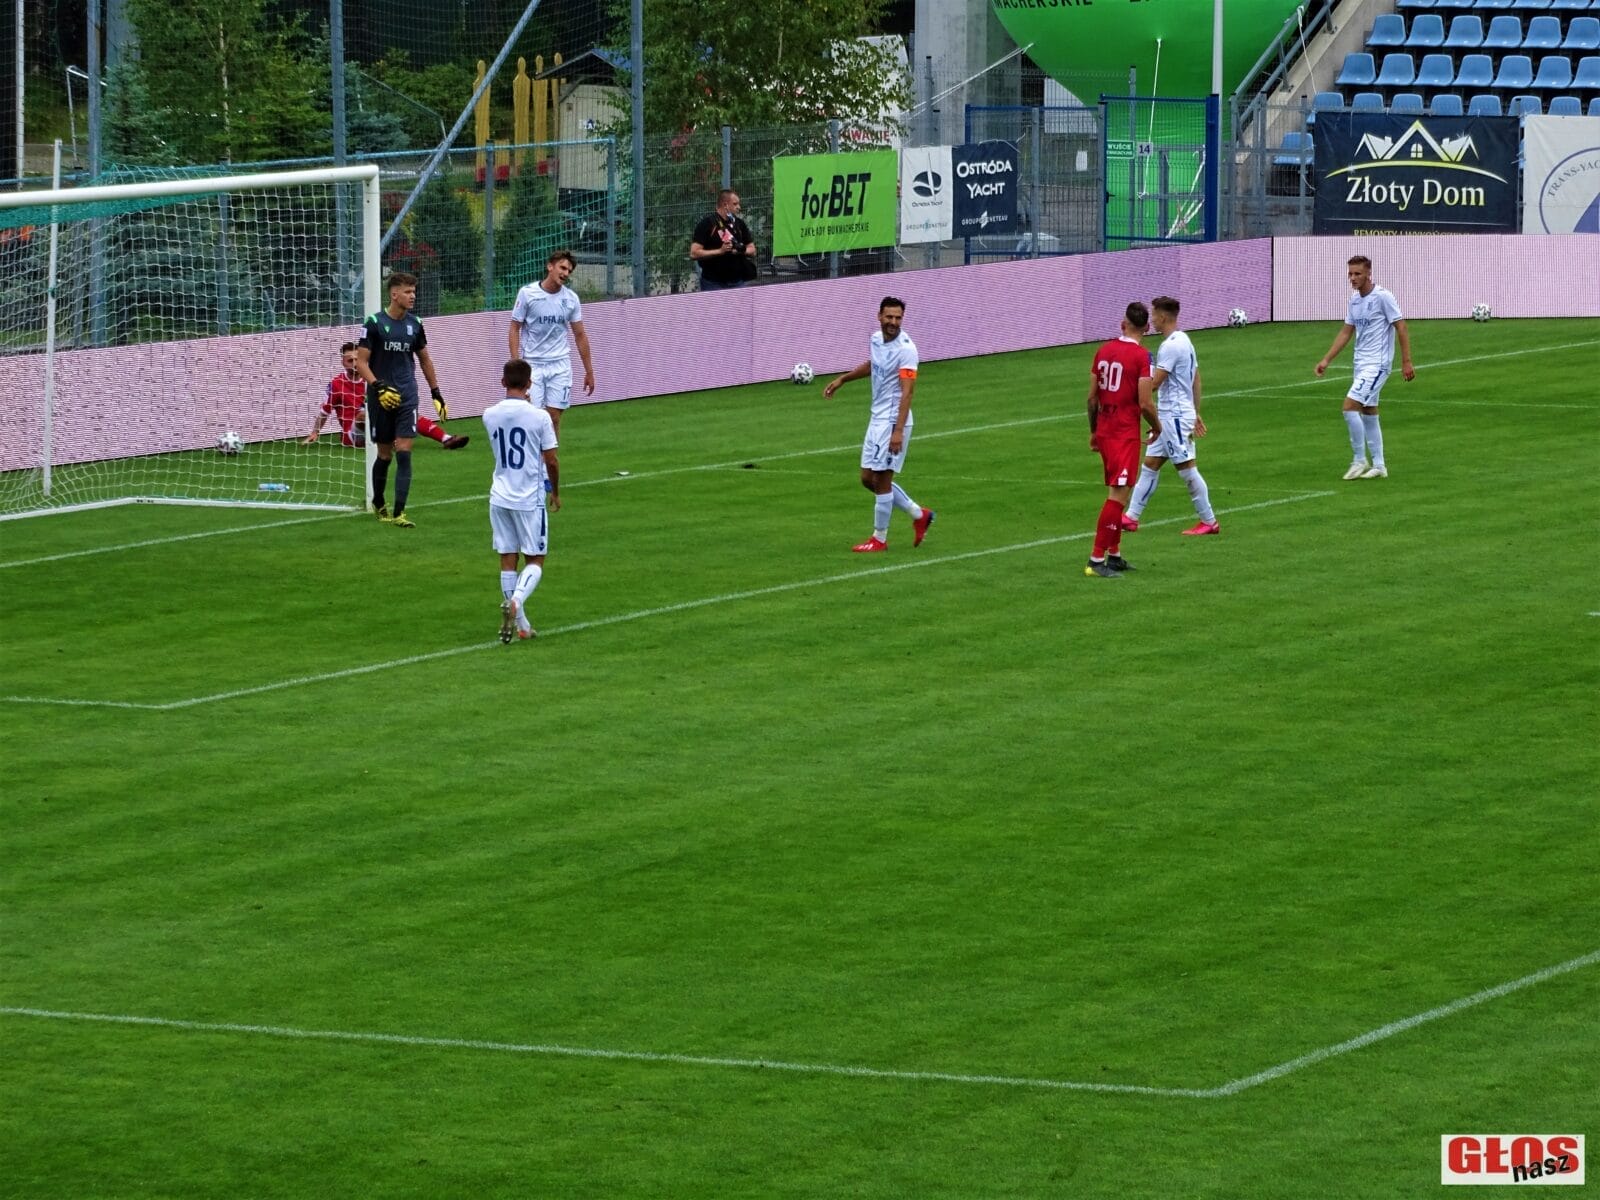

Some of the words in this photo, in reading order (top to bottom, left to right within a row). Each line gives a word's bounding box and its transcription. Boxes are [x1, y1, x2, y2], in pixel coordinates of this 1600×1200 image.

[1139, 144, 1150, 154] 14
[957, 160, 1012, 178] OSTRÓDA
[801, 172, 871, 220] forBET
[966, 183, 1005, 199] YACHT
[1346, 175, 1414, 211] Złoty
[1423, 179, 1485, 206] Dom
[1097, 360, 1124, 392] 30
[1355, 378, 1366, 391] 3
[493, 426, 527, 470] 18
[872, 444, 881, 460] 2
[1167, 440, 1175, 456] 8
